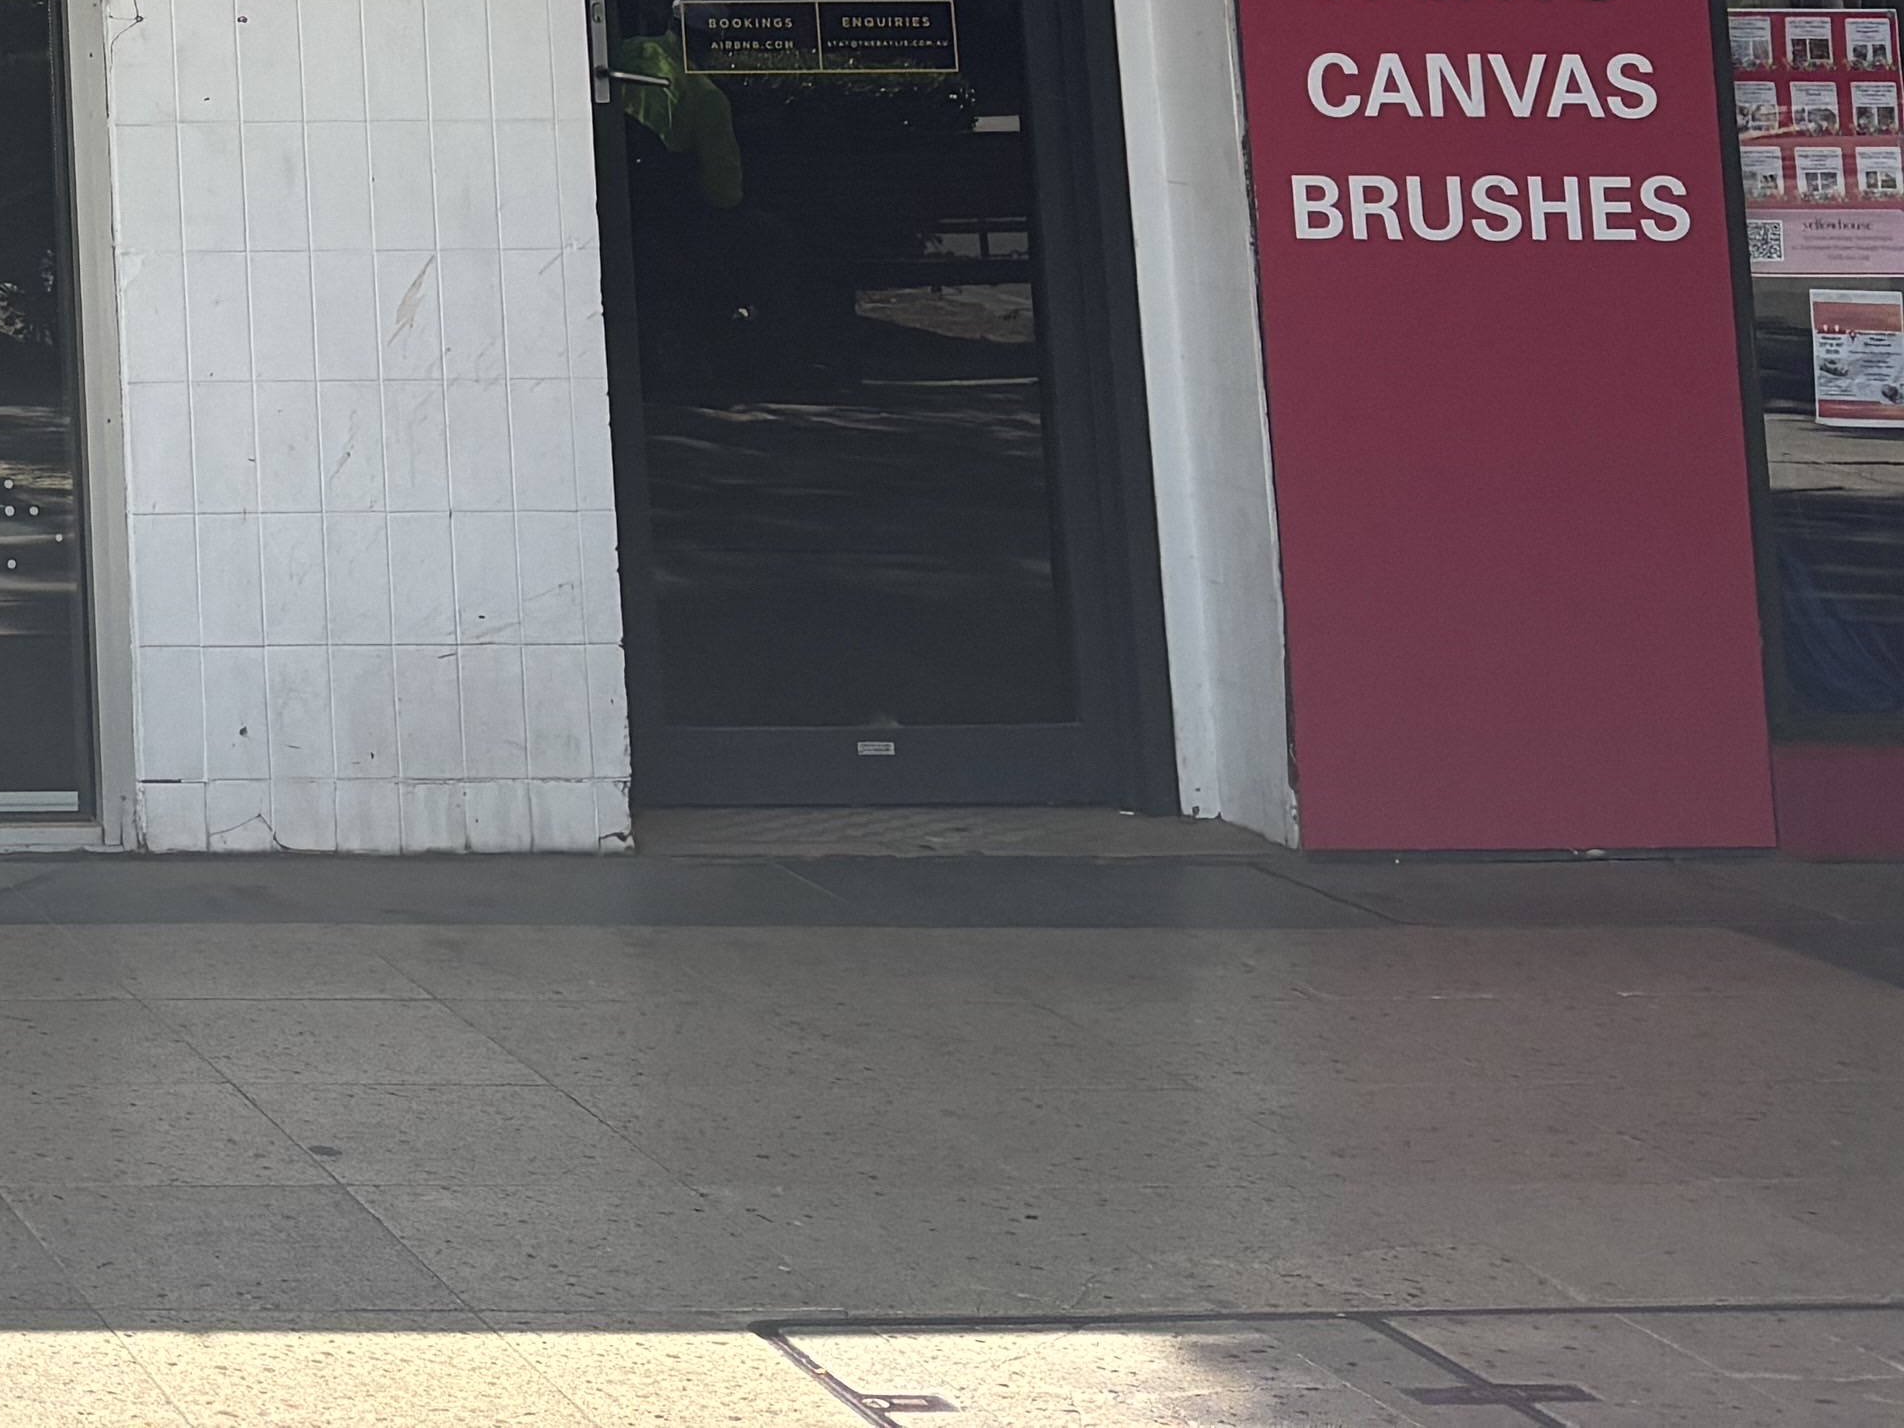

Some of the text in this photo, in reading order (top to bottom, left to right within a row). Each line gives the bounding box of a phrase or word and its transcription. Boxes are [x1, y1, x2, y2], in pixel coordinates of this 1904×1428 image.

[708, 16, 931, 29] BOOKINGS ENQUIRIES
[1307, 52, 1658, 120] CANVAS
[1291, 175, 1691, 241] BRUSHES
